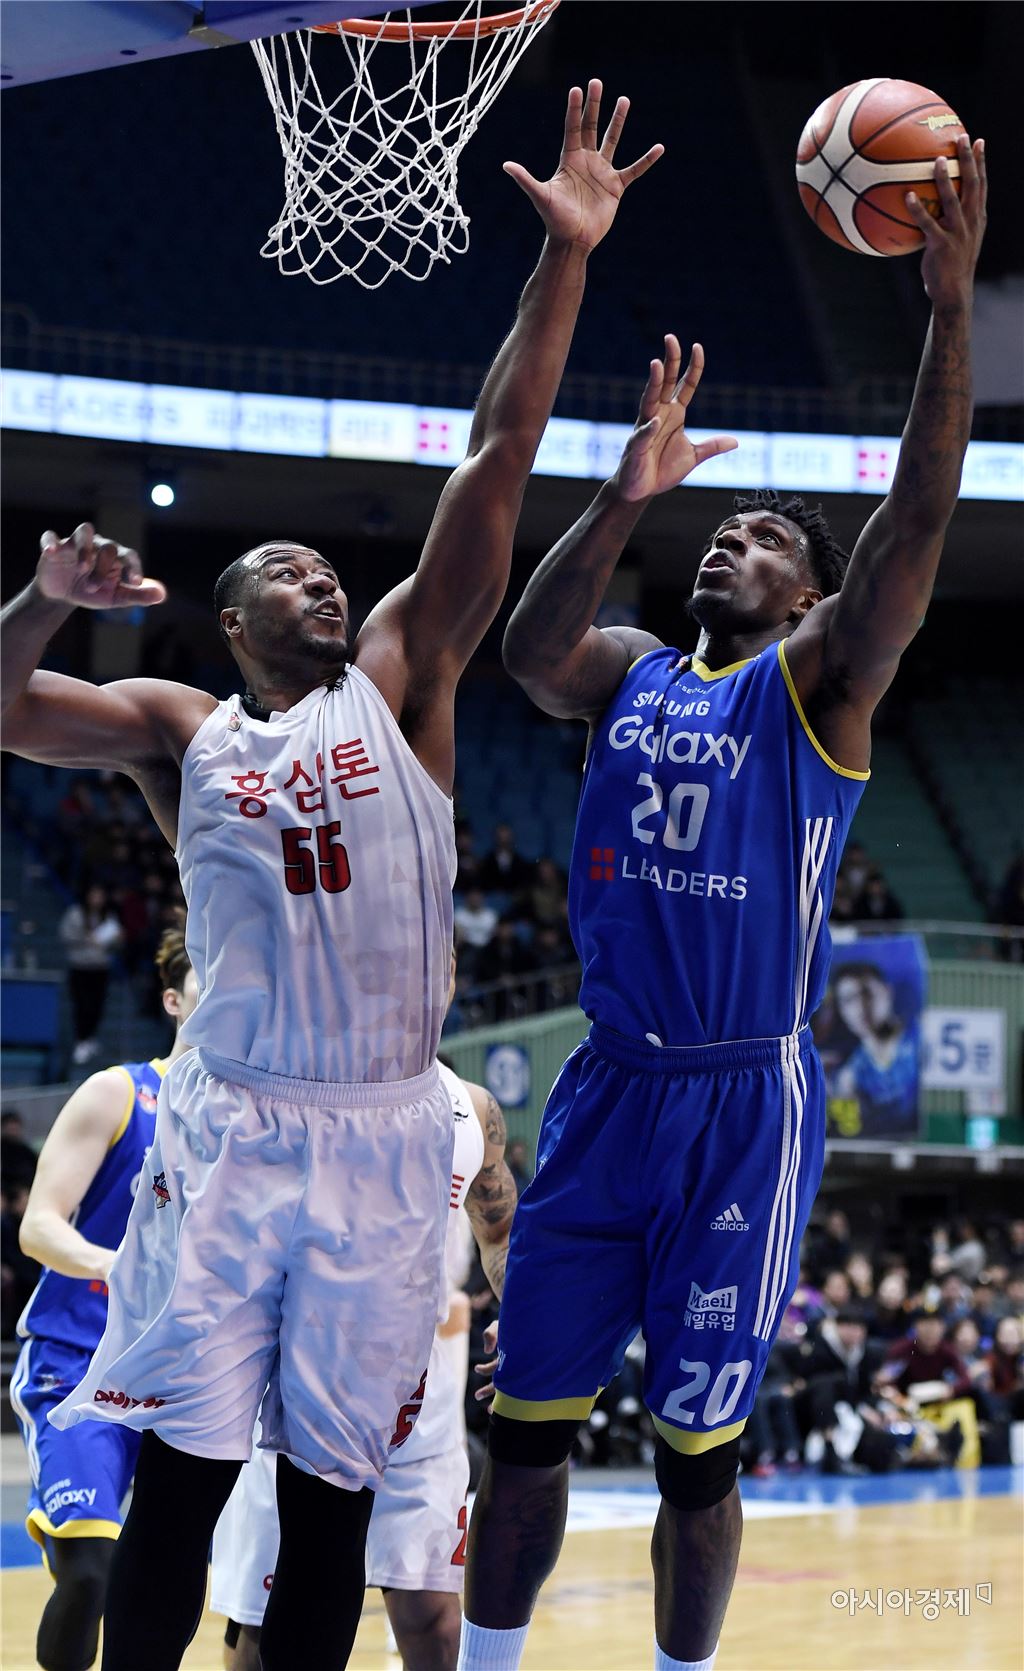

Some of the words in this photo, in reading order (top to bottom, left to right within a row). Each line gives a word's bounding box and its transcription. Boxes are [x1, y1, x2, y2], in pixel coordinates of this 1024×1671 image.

[224, 738, 380, 819] 홍삼톤
[608, 715, 753, 780] Galaxy
[631, 772, 710, 852] 20
[280, 820, 352, 896] 55
[621, 855, 748, 901] LEADERS
[710, 1220, 750, 1231] adidas
[690, 1290, 732, 1309] Maeil
[661, 1357, 753, 1427] 20
[45, 1488, 97, 1518] alaxy
